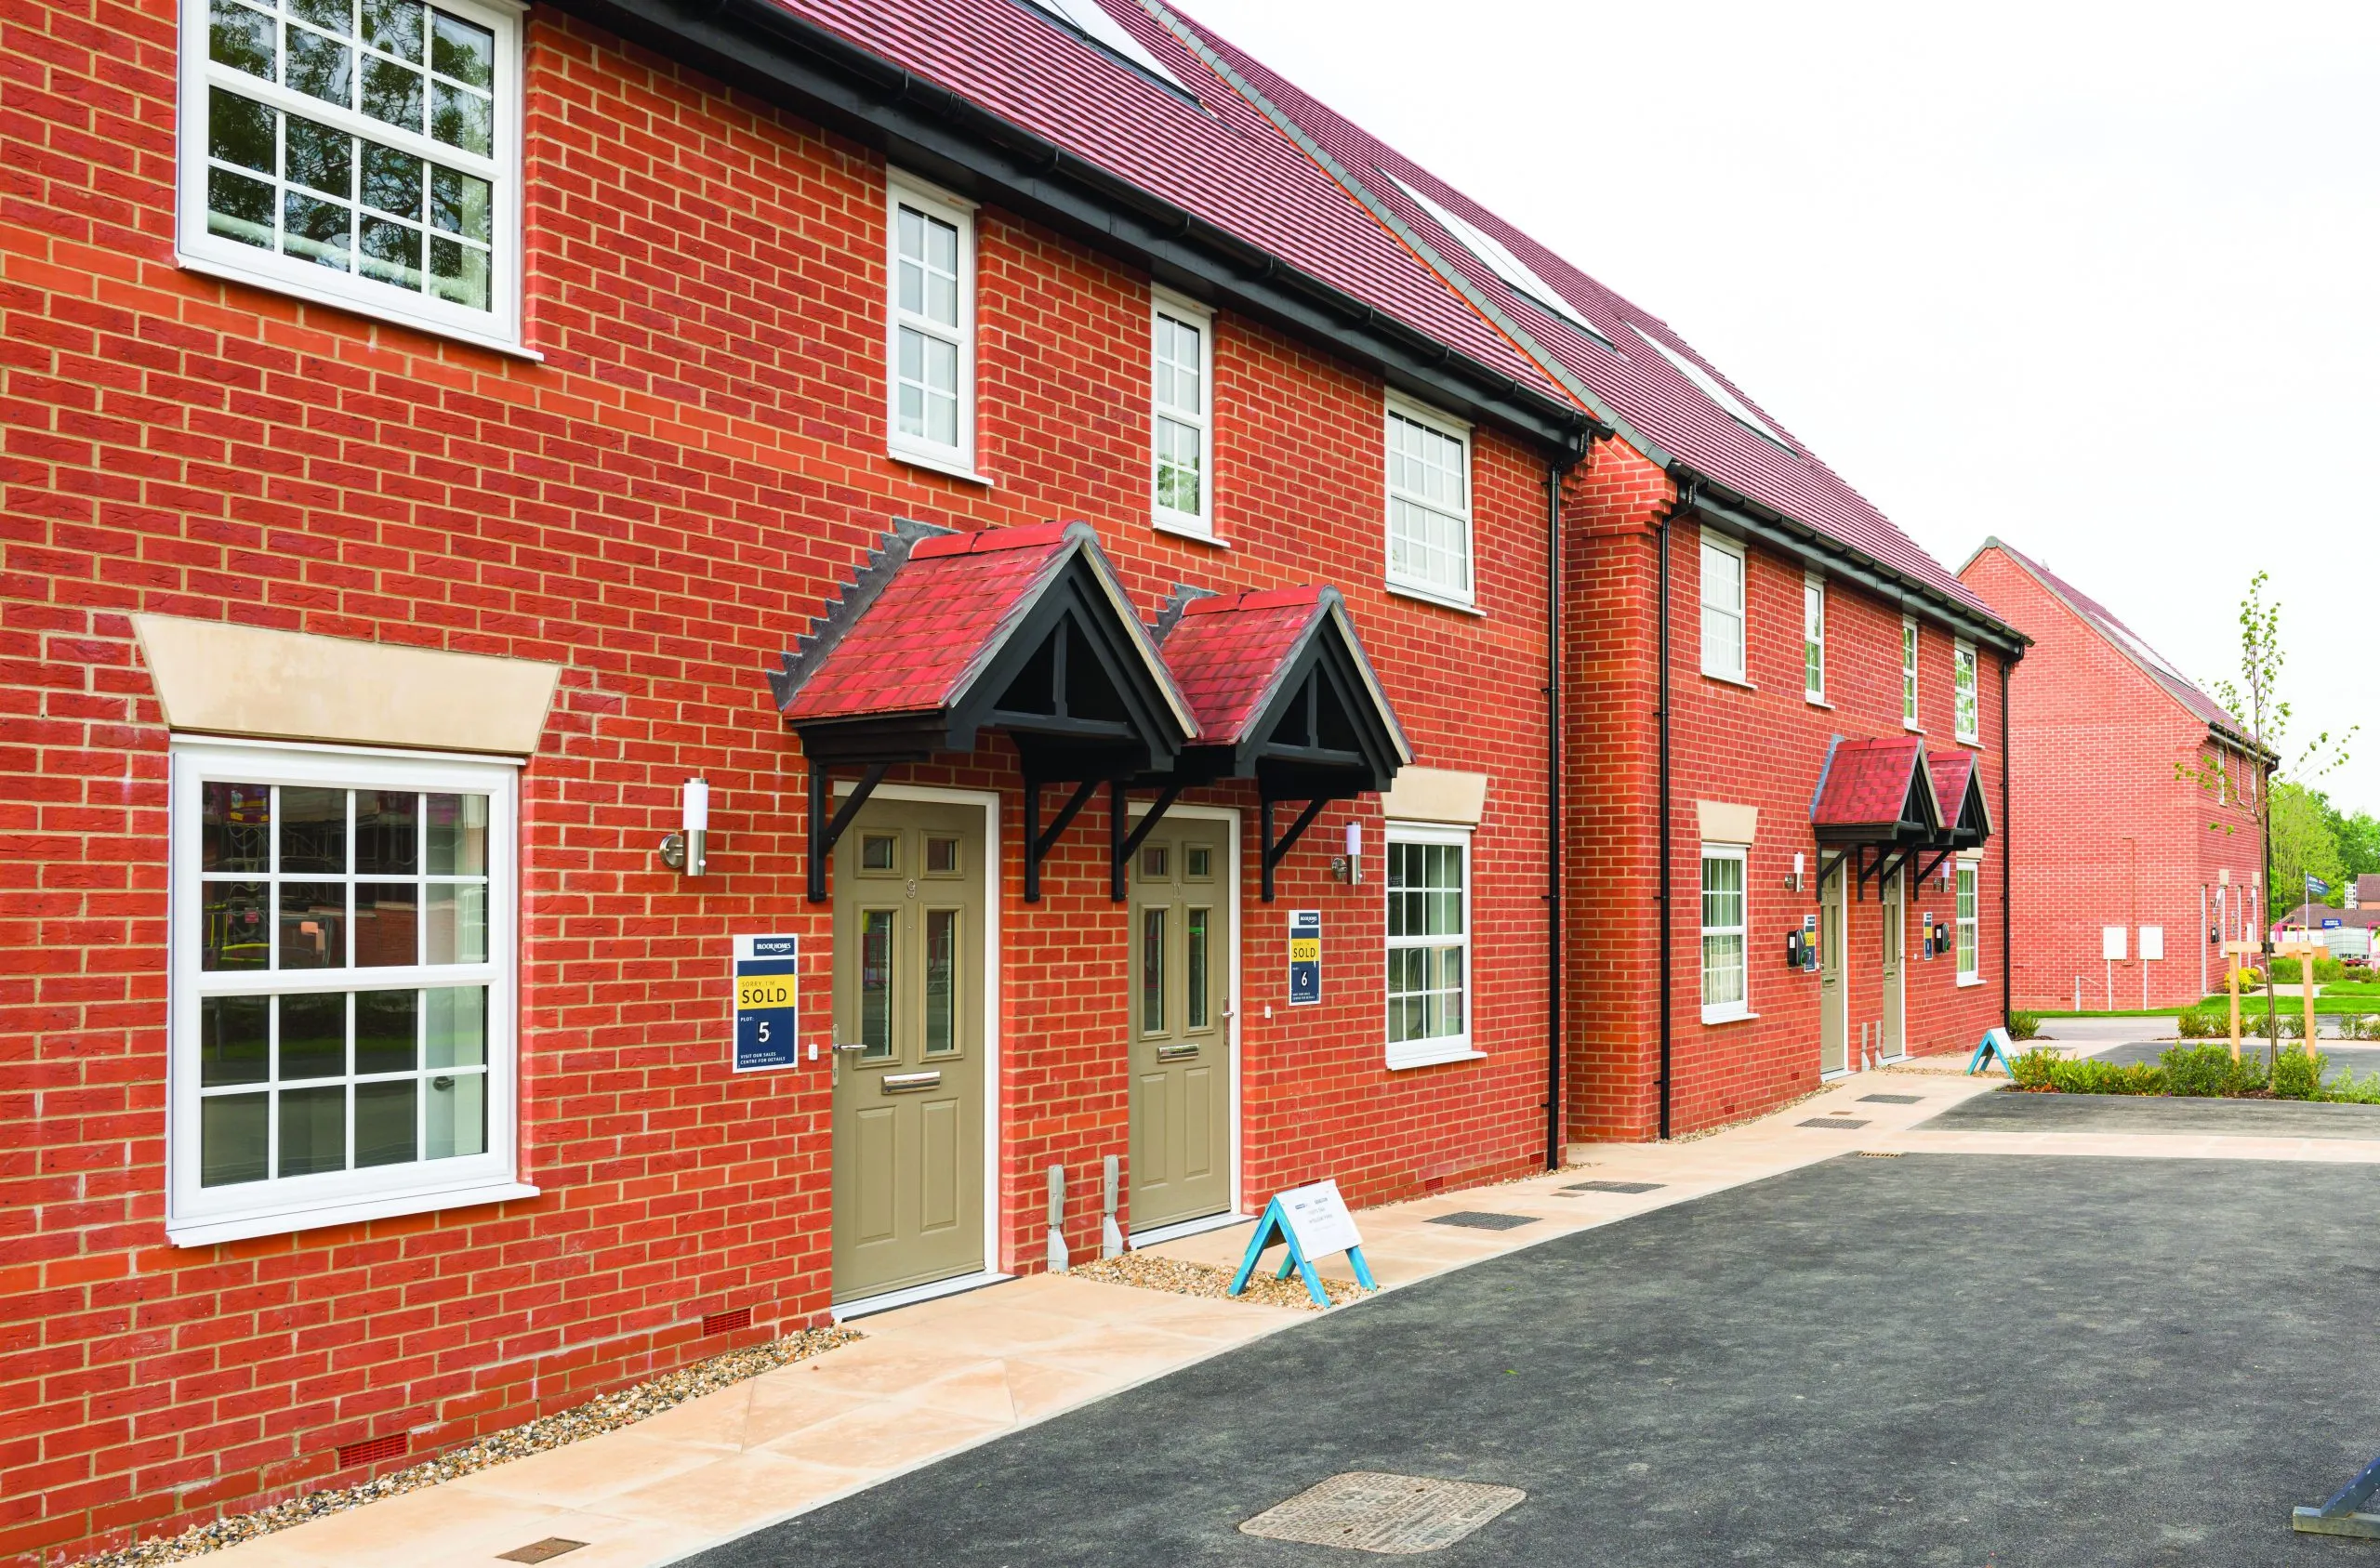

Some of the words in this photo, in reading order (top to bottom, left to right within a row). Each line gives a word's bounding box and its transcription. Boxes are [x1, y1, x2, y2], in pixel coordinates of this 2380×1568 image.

[1294, 948, 1316, 957] SOLD
[1302, 971, 1308, 986] 6
[742, 988, 787, 1004] SOLD
[759, 1021, 770, 1043] 5
